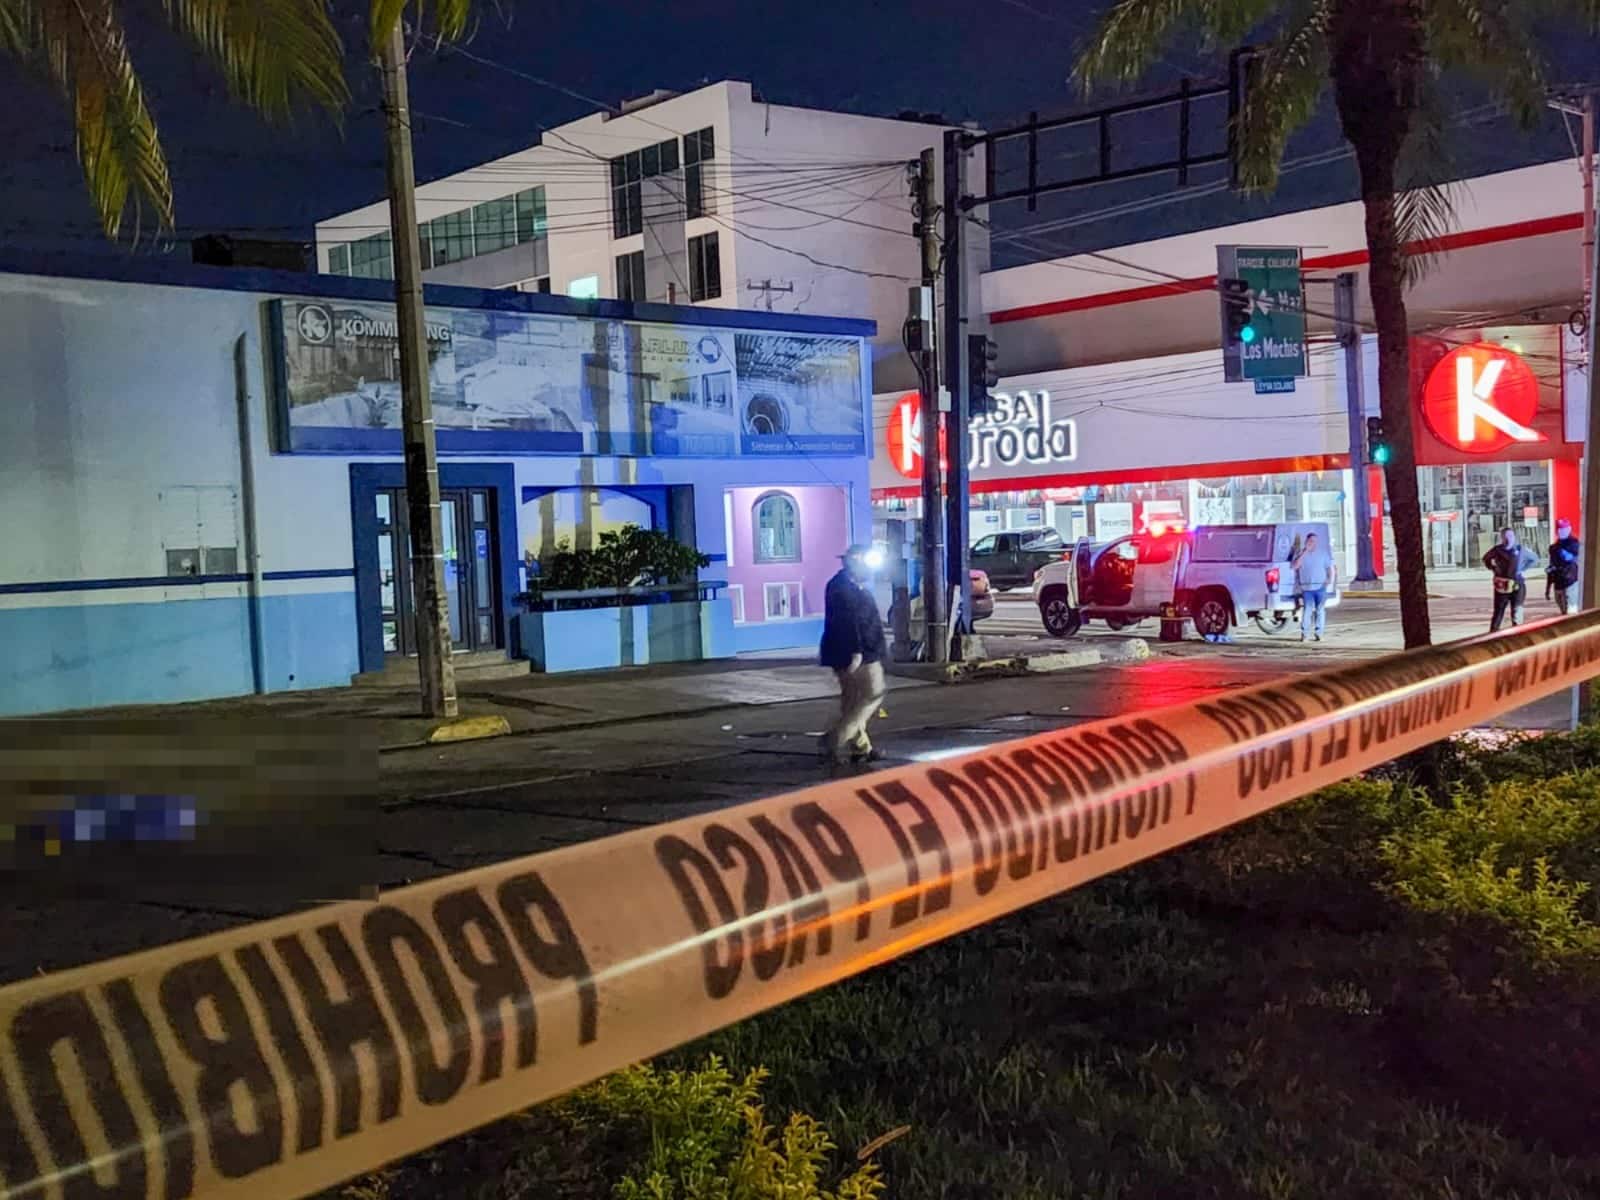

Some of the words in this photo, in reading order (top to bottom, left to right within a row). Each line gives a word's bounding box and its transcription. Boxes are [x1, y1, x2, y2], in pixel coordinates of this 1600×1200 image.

[342, 316, 450, 341] KÖMMNG
[1243, 342, 1261, 359] Los
[1263, 337, 1299, 359] Mochis
[1456, 356, 1542, 442] K
